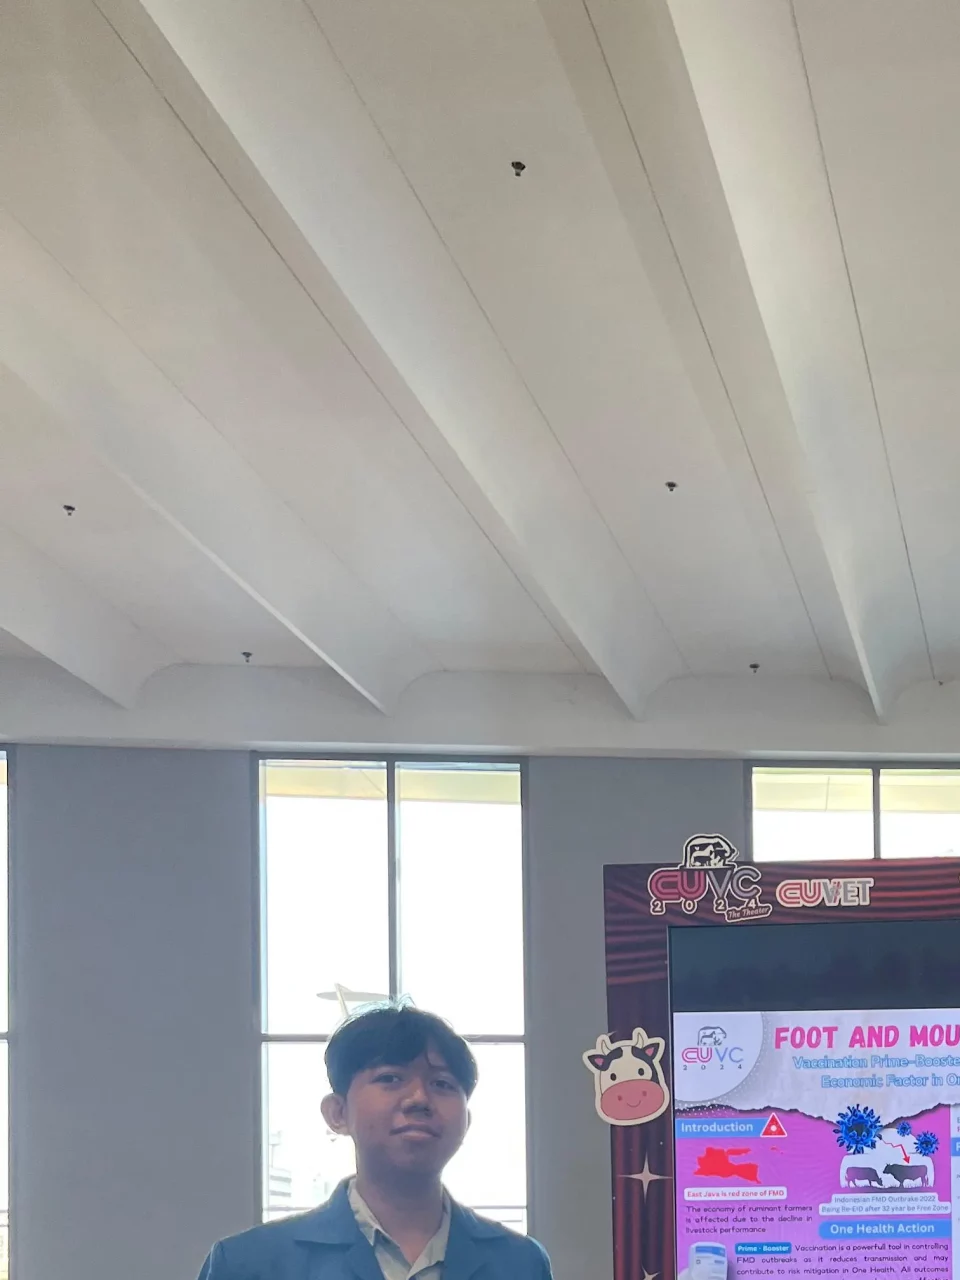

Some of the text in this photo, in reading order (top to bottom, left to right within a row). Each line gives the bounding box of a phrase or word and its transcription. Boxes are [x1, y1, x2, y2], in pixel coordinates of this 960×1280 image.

[650, 867, 761, 901] CUVC
[777, 879, 872, 905] CUVET
[728, 905, 769, 919] The Theater
[774, 1026, 838, 1049] FOOT
[848, 1026, 900, 1048] AND
[682, 1047, 744, 1064] CUVC
[792, 1055, 868, 1070] Vaccination
[821, 1073, 884, 1088] Economic
[886, 1073, 929, 1088] Factor
[931, 1073, 943, 1086] in
[681, 1122, 754, 1132] Introduction
[687, 1190, 702, 1198] East
[703, 1190, 720, 1198] Java
[703, 1206, 735, 1214] economy
[737, 1205, 746, 1213] of
[719, 1226, 766, 1235] performance
[830, 1223, 935, 1235] One Health Action
